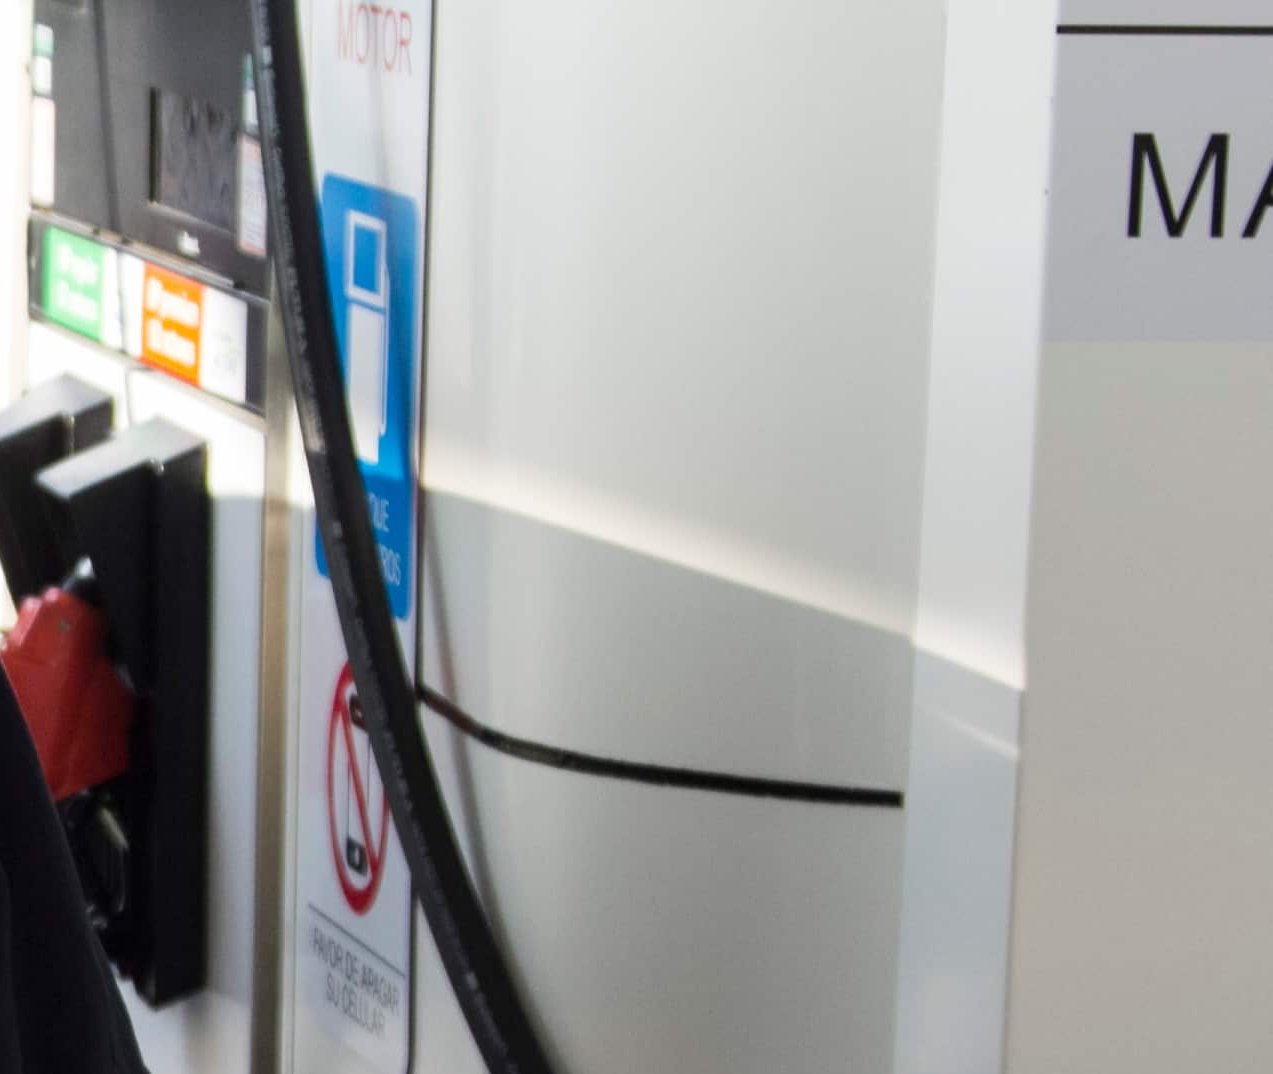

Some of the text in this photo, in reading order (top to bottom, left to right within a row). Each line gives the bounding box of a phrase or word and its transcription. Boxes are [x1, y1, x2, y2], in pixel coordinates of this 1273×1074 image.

[337, 0, 412, 77] MOTOR
[313, 926, 399, 1015] FAVOR DE APAGAR
[326, 972, 385, 1039] SU CELULAR
